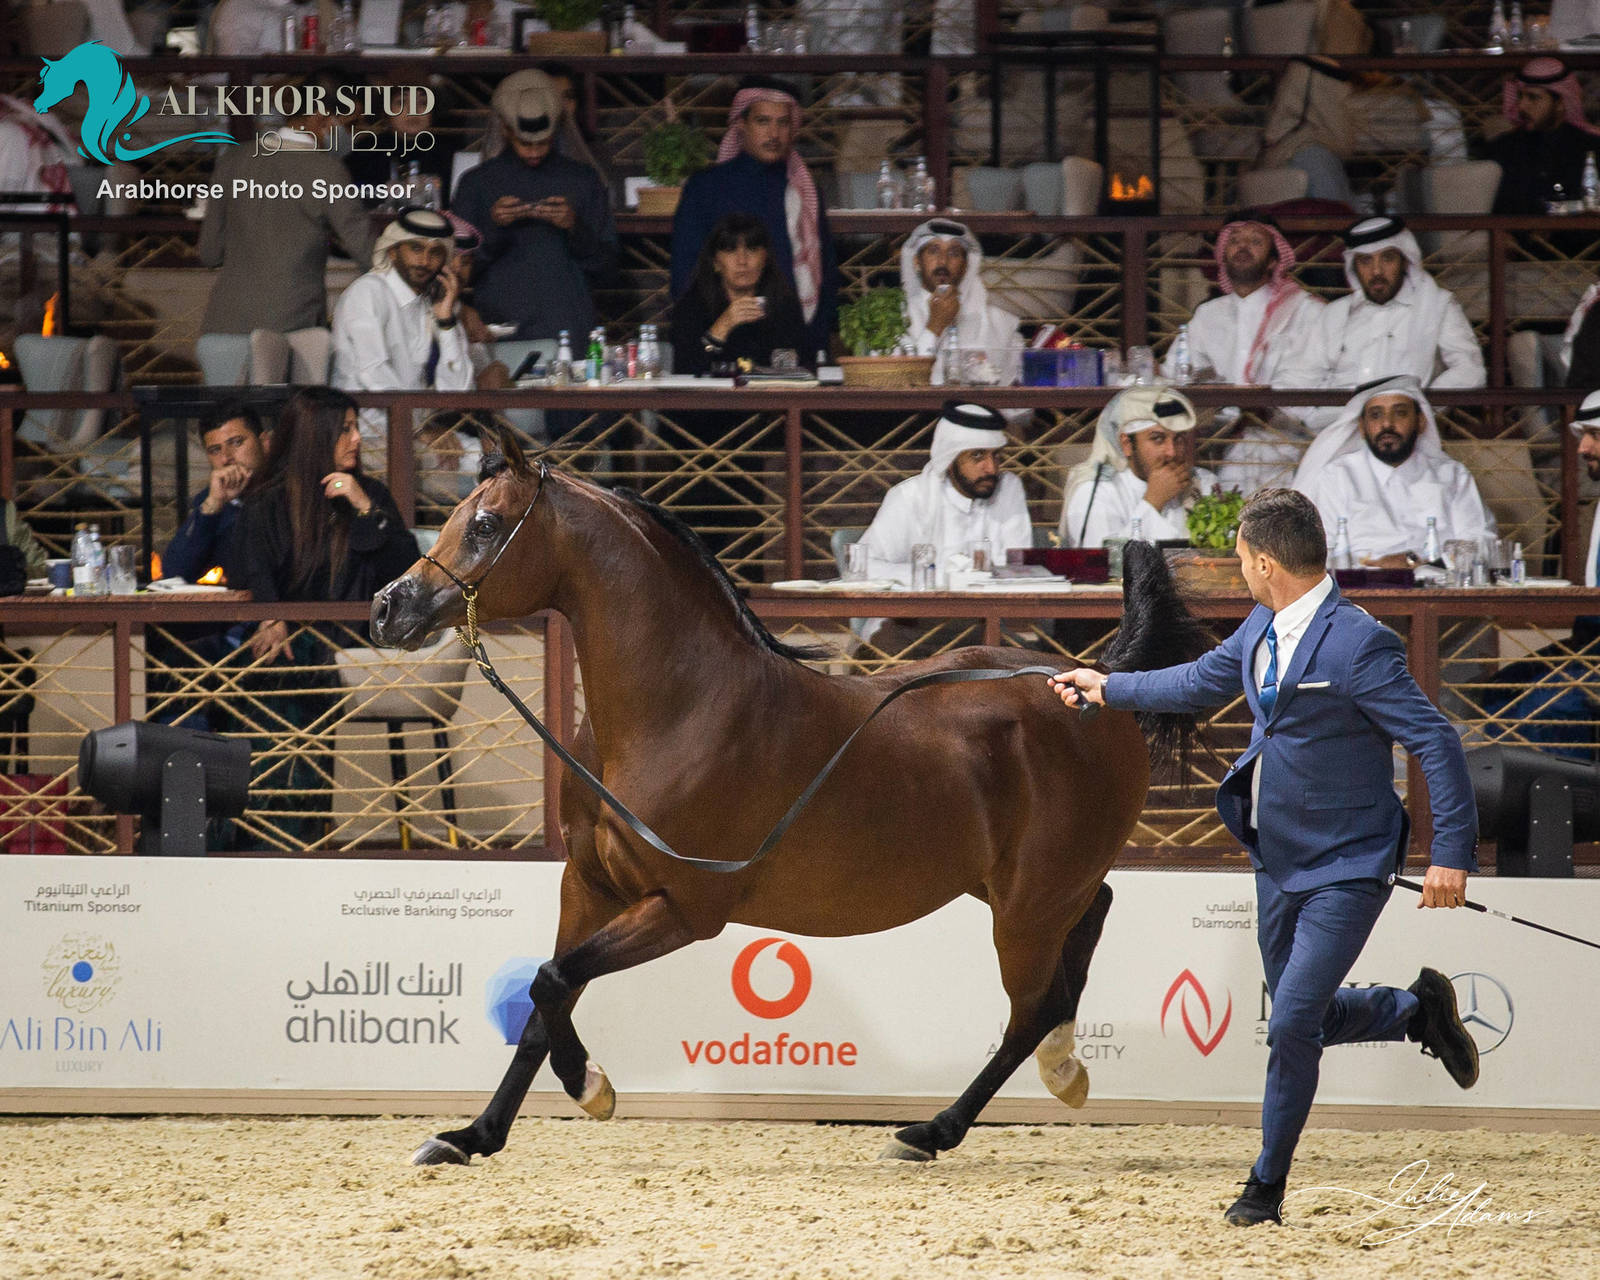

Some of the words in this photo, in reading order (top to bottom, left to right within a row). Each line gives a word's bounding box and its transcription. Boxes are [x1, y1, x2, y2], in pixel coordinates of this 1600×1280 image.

[90, 884, 131, 898] الراعي
[462, 889, 502, 904] الراعي
[24, 900, 84, 913] Titanium
[88, 901, 141, 915] Sponsor
[341, 904, 400, 917] Exclusive
[404, 905, 457, 919] Banking
[460, 905, 515, 919] Sponsor
[1192, 917, 1252, 929] Diamond
[286, 961, 390, 1009] الأهلي
[397, 962, 463, 1005] البنك
[0, 1017, 41, 1051] Ali
[54, 1016, 107, 1051] Bin
[119, 1018, 162, 1052] Ali
[286, 1009, 460, 1045] ahlibank
[681, 1032, 858, 1066] vodafone
[1081, 1044, 1126, 1060] CITY
[55, 1061, 104, 1073] LUXURY
